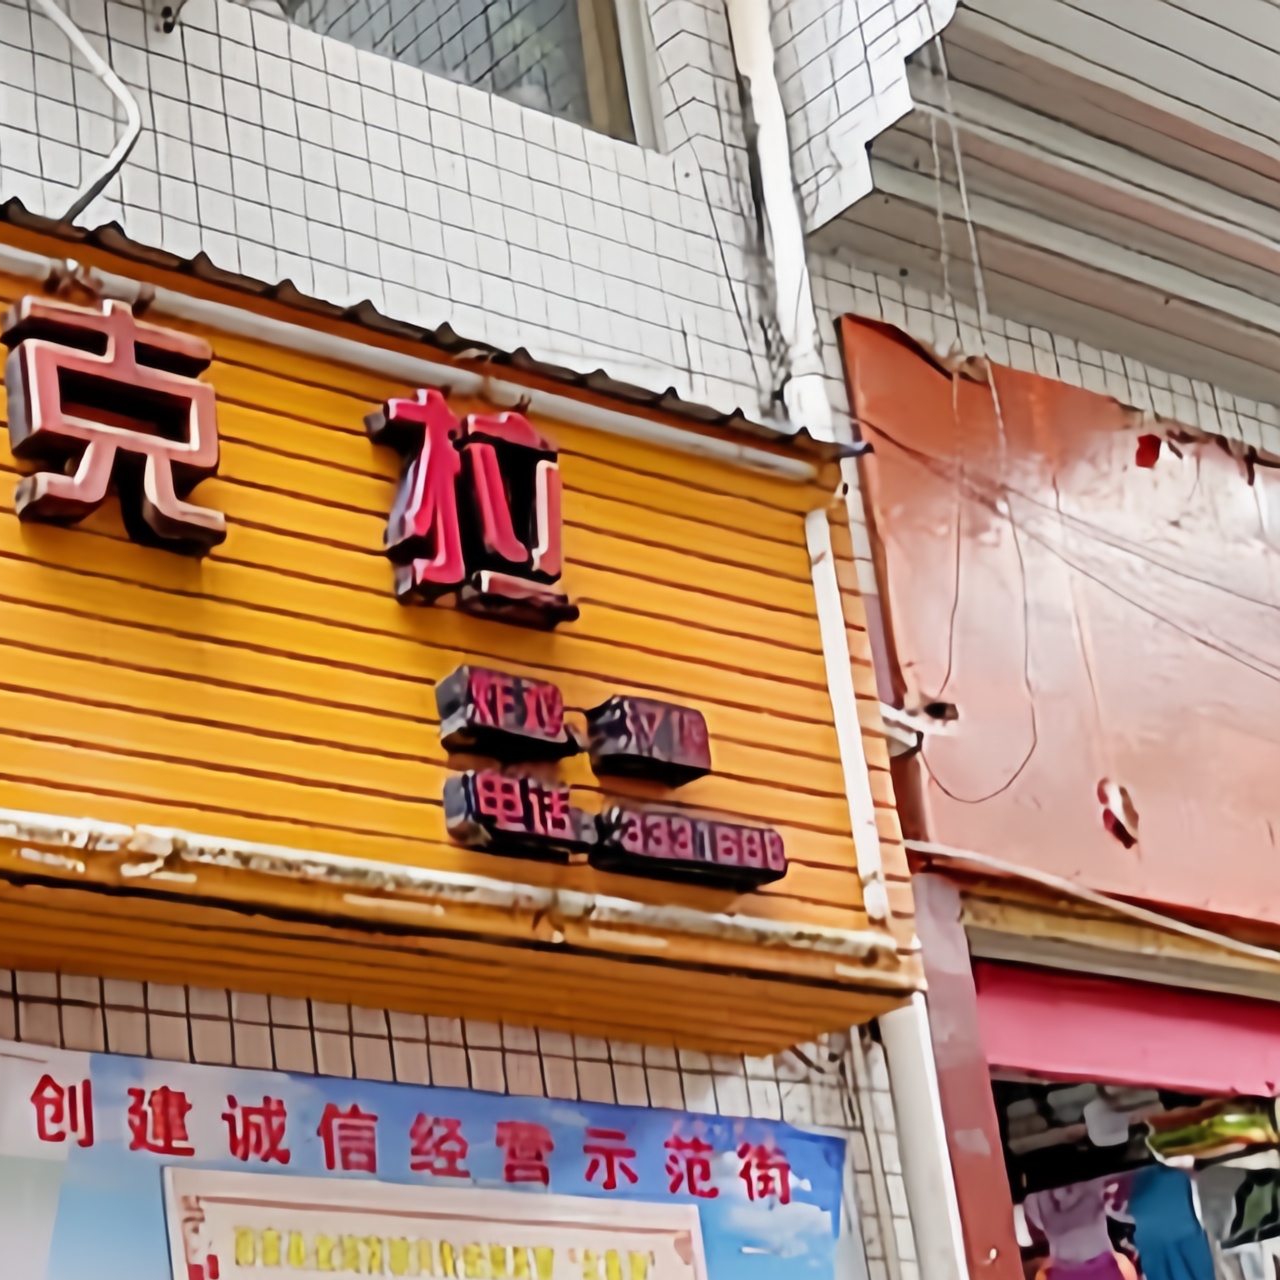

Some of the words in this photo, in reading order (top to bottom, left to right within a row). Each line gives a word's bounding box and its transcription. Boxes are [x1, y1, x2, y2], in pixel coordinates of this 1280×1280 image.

[30, 1074, 793, 1206] 创建诚信经营示范街
